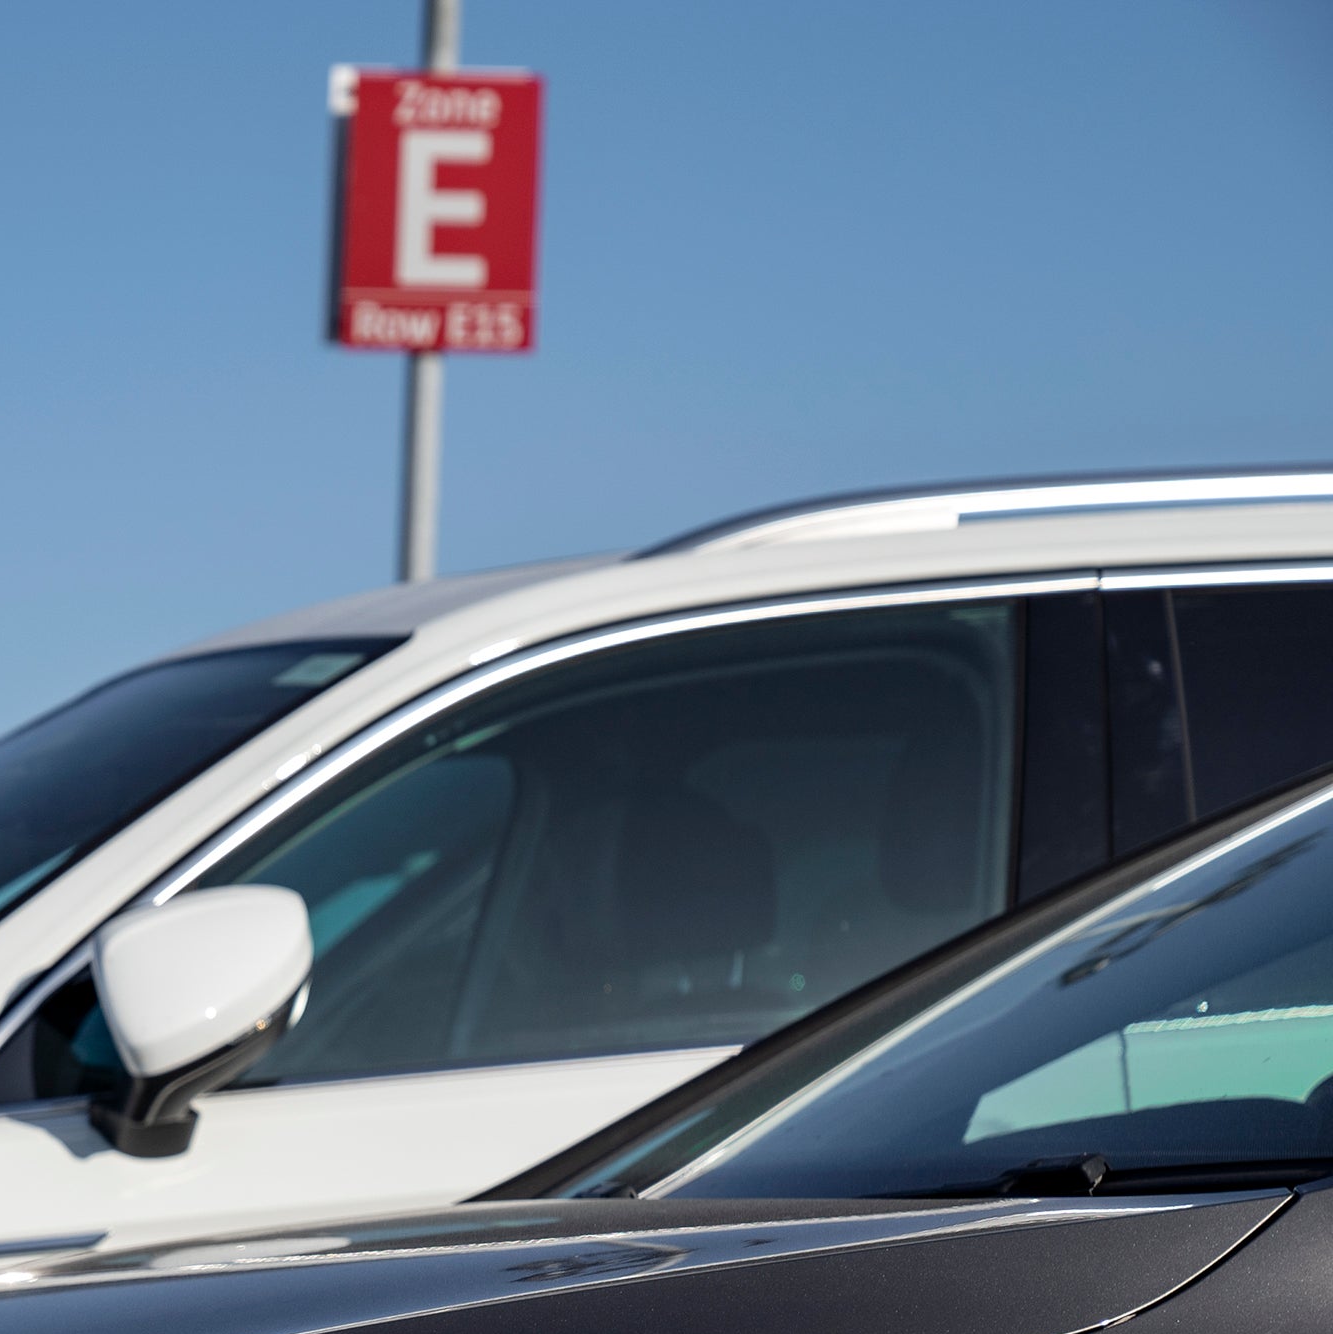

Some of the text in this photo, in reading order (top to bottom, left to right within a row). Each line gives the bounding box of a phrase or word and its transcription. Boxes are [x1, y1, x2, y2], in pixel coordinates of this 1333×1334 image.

[394, 81, 501, 128] Zone
[396, 130, 491, 288] E
[351, 300, 439, 347] Row
